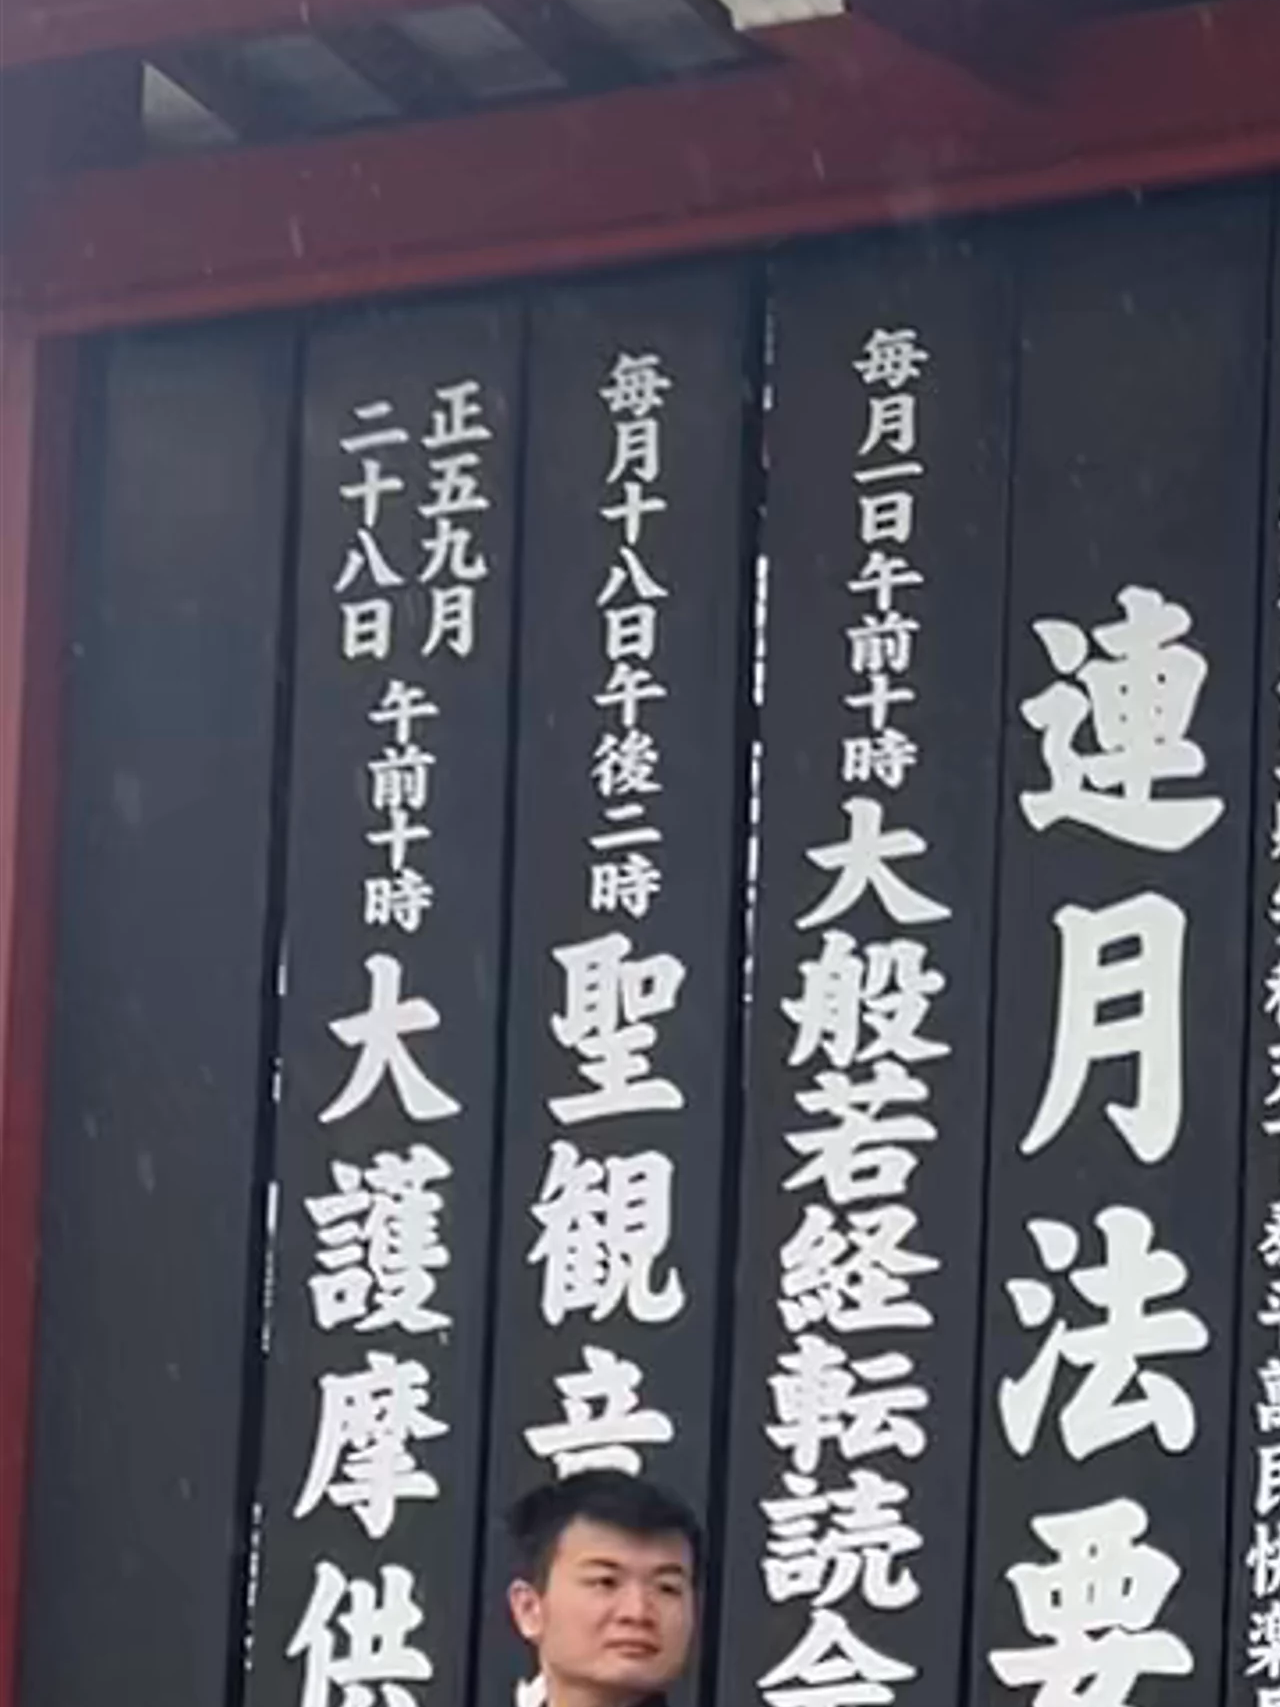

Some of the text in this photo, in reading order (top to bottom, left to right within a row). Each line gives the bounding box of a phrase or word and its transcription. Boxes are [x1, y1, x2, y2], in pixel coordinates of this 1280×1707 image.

[334, 401, 408, 660] 二十八日
[419, 379, 492, 657] 正五九月
[364, 680, 439, 932] 午前十時
